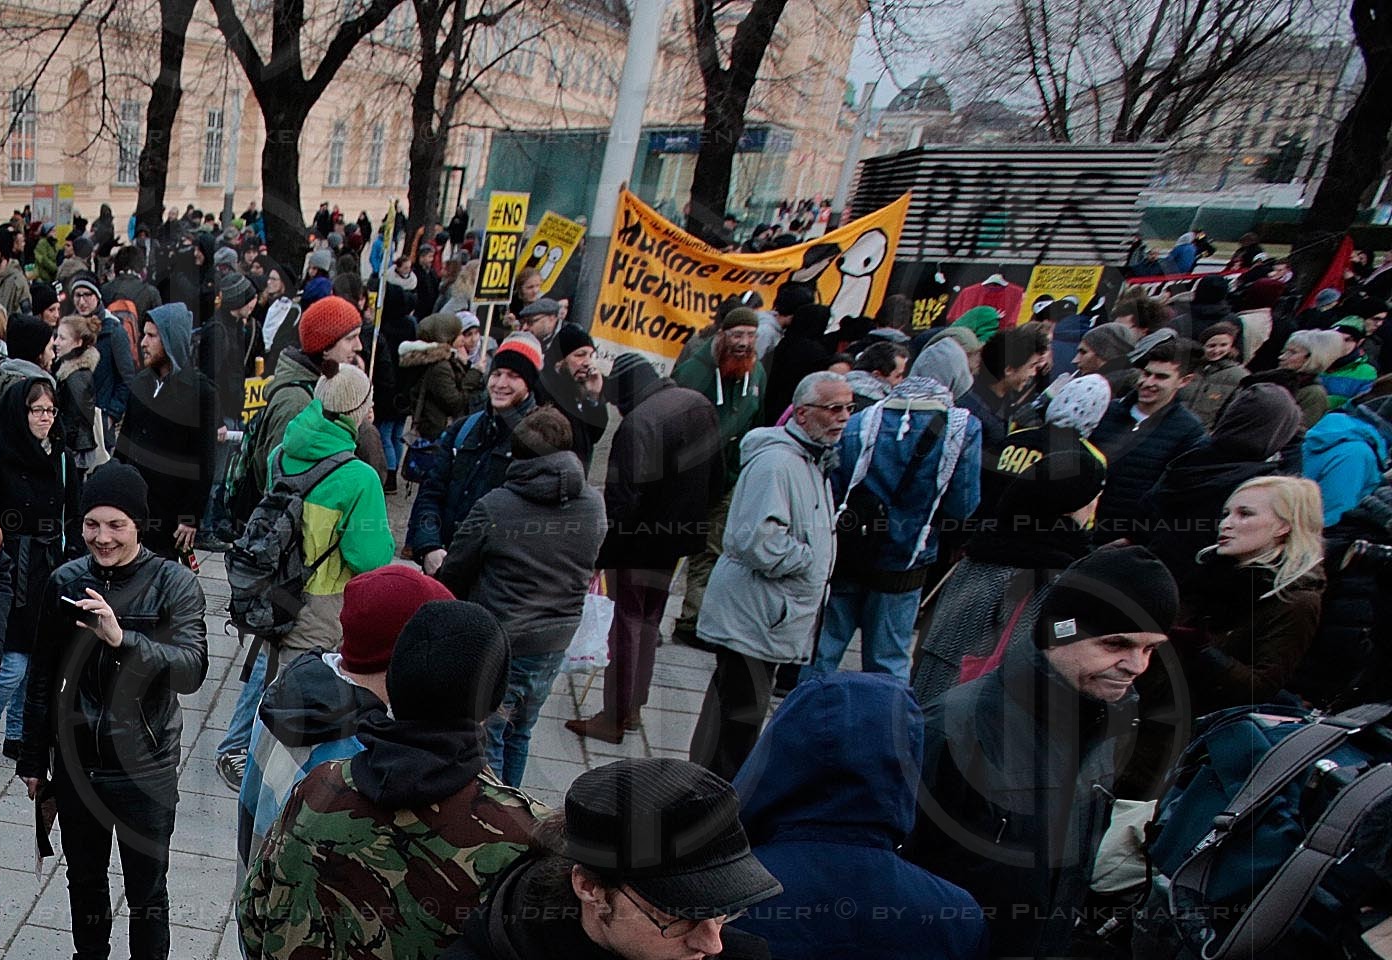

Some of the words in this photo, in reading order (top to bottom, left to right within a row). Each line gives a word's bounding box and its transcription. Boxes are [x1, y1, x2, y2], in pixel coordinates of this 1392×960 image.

[492, 202, 522, 226] #NO
[488, 234, 518, 261] PEG
[481, 262, 511, 288] IDA
[721, 267, 790, 285] und
